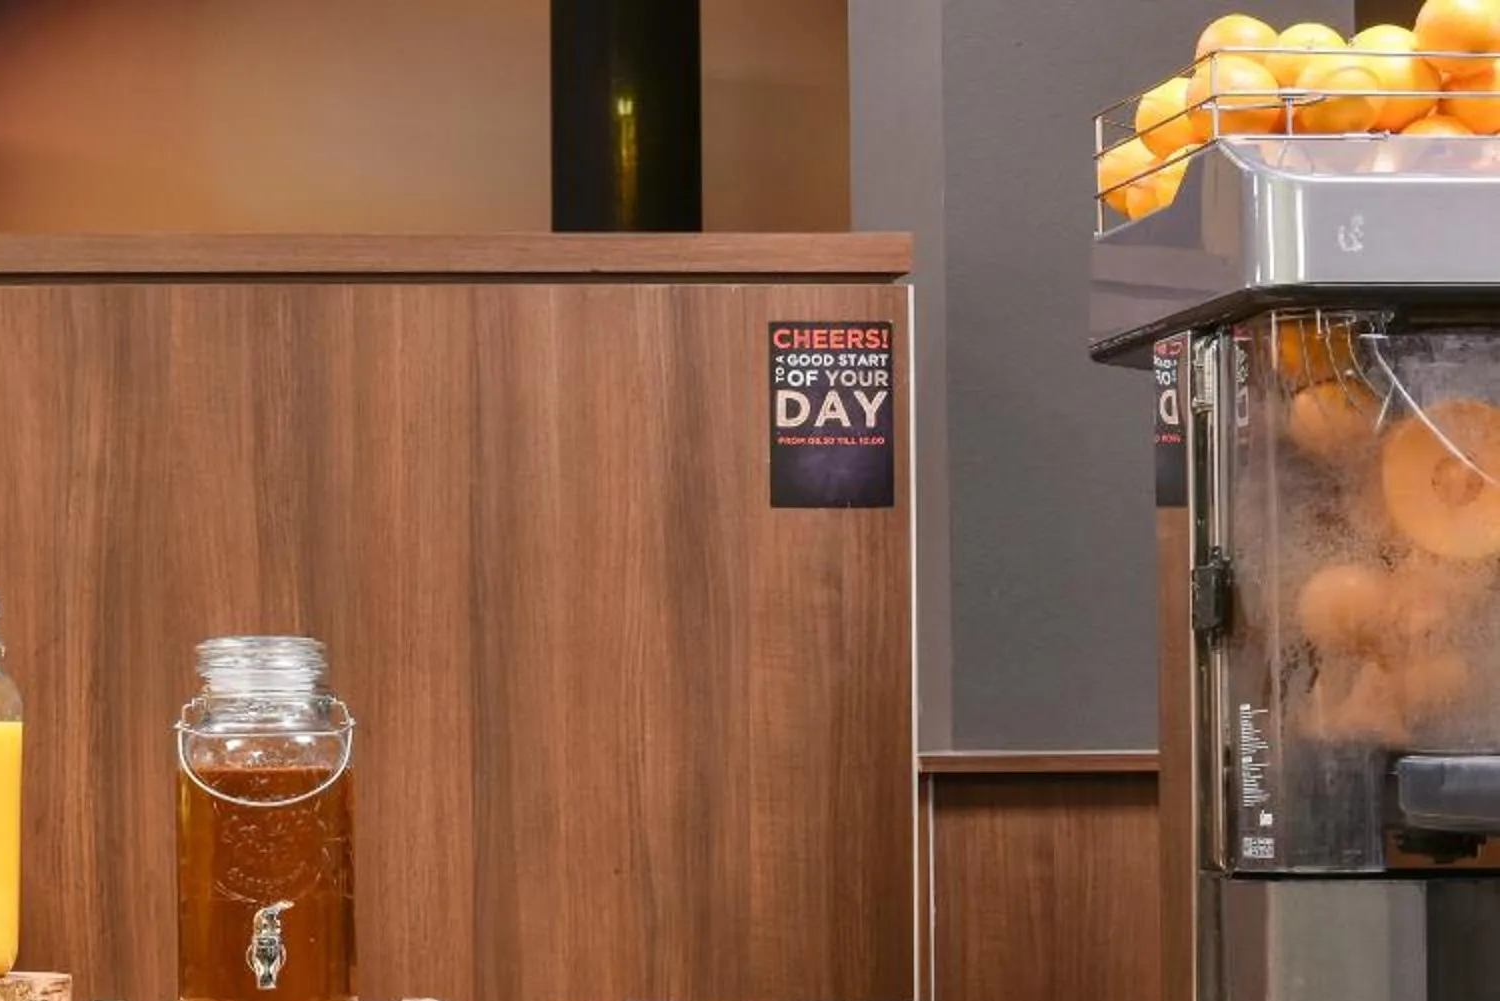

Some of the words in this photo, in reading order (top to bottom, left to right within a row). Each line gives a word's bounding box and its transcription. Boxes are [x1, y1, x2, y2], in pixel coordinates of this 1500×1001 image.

[773, 329, 889, 349] CHEERS!
[787, 354, 835, 367] GOOD
[838, 354, 889, 367] START
[787, 370, 818, 387] OF
[825, 370, 889, 387] YOUR
[776, 389, 889, 429] DAY
